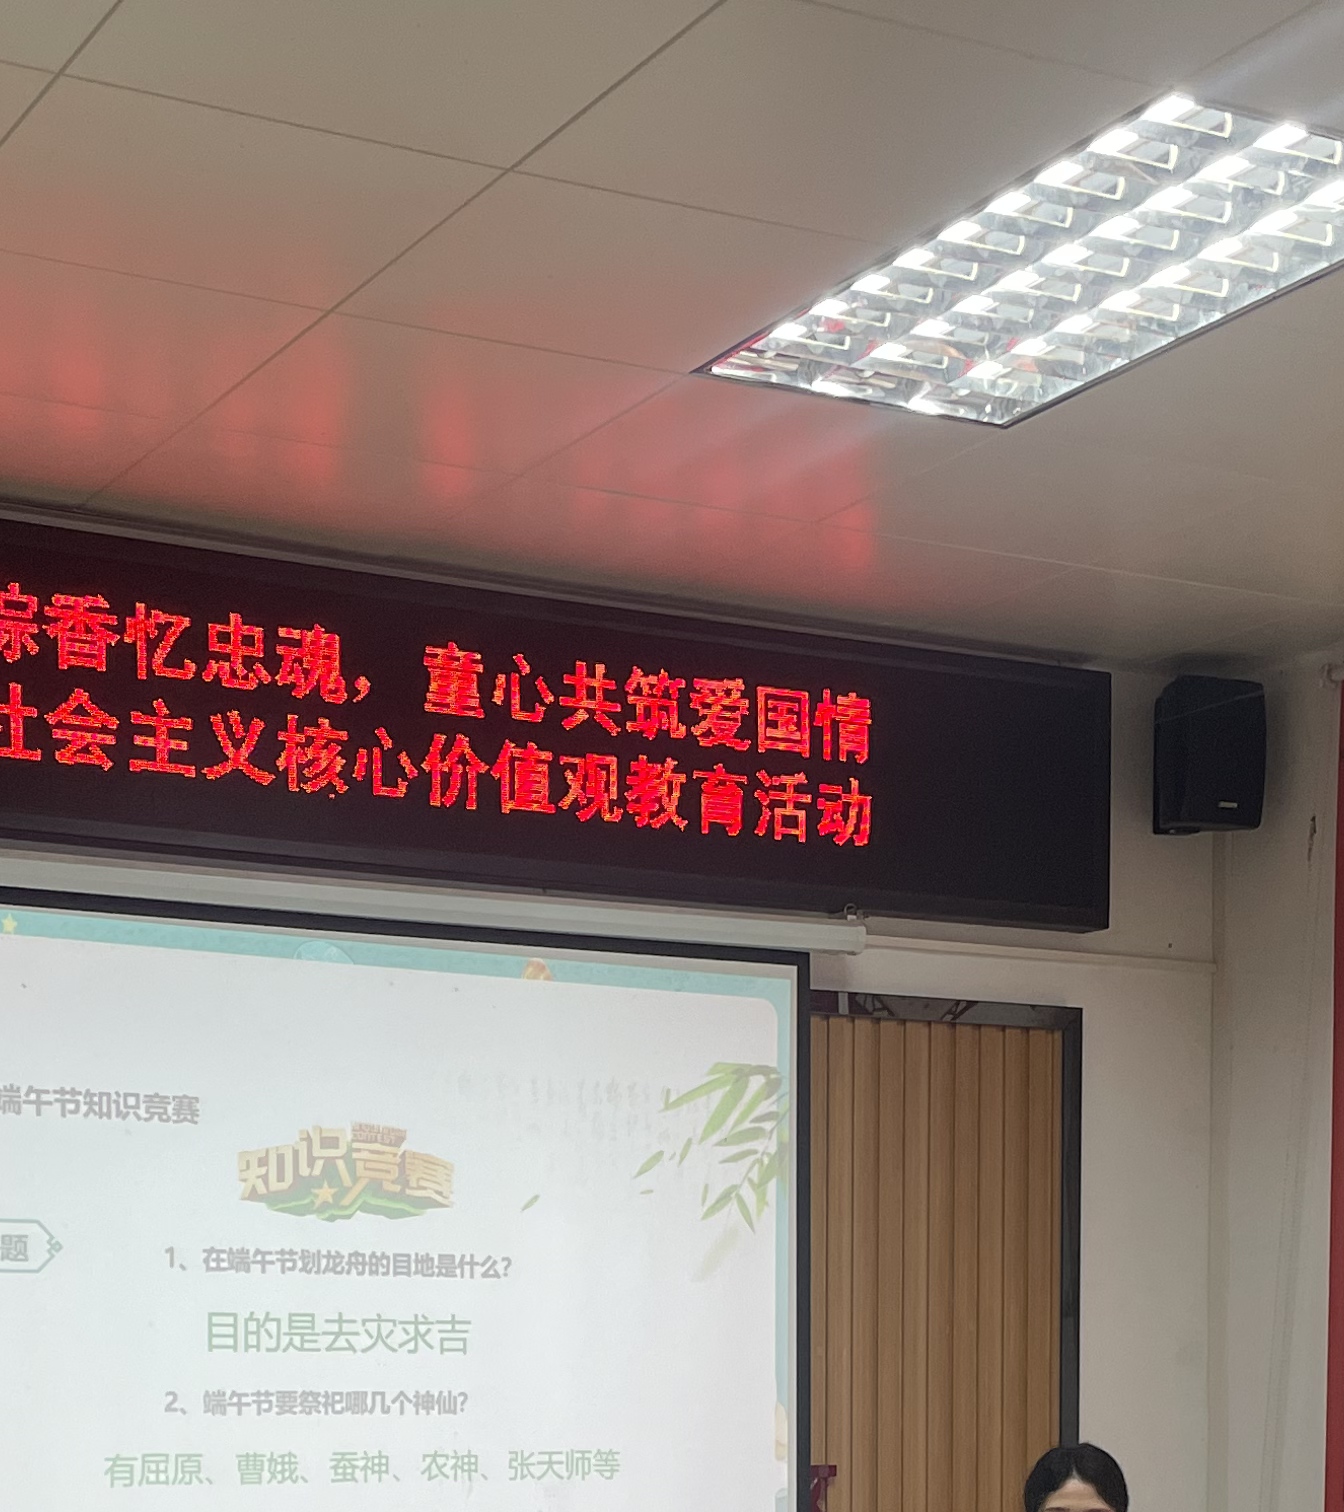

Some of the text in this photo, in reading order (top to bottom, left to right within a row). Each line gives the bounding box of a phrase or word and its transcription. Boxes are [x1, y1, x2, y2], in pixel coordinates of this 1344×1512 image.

[237, 1126, 455, 1206] 知识竞赛
[206, 1311, 472, 1356] 目的是去灾求吉
[103, 1448, 621, 1489] 有屈原、曹娥、蚕神、农神、张天师等
